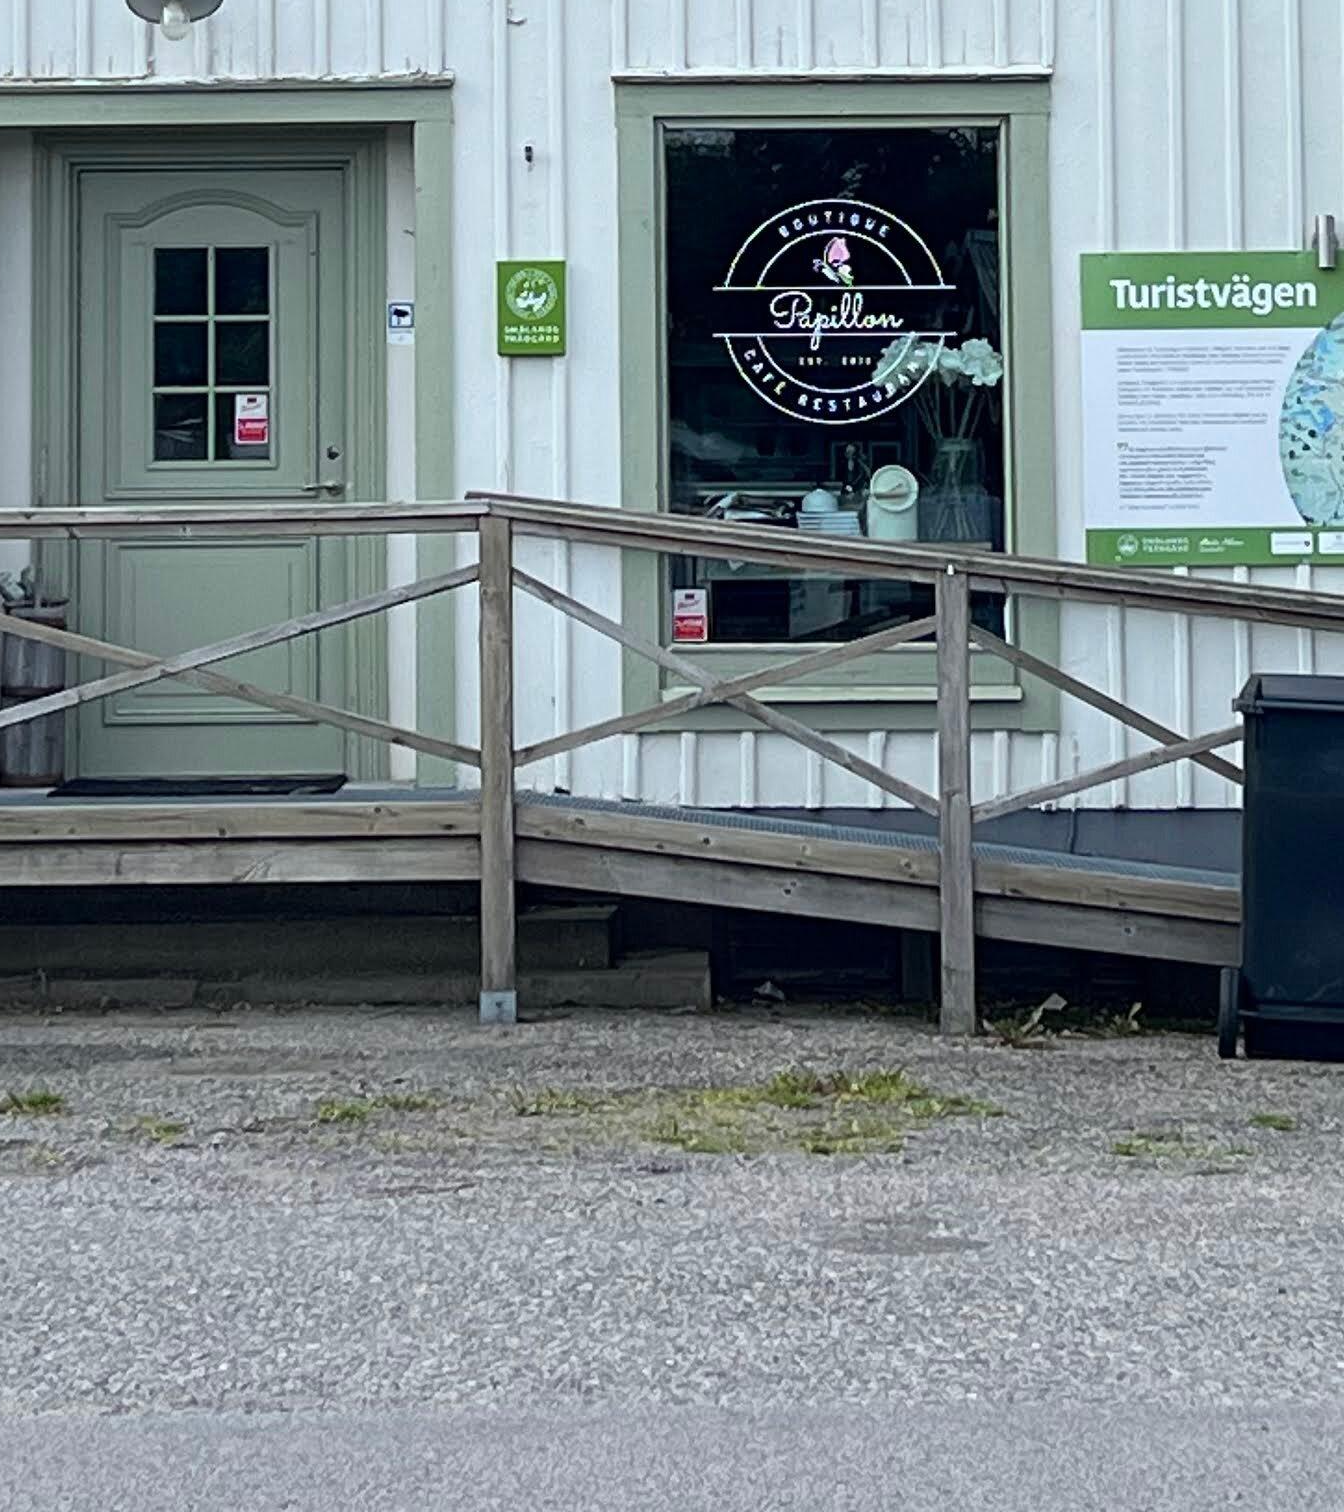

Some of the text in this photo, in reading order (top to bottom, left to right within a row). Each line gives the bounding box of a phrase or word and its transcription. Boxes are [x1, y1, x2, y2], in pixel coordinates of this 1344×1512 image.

[778, 210, 890, 237] BOUTIQUE
[1109, 274, 1317, 315] Turistvägen
[769, 290, 904, 351] Papillon
